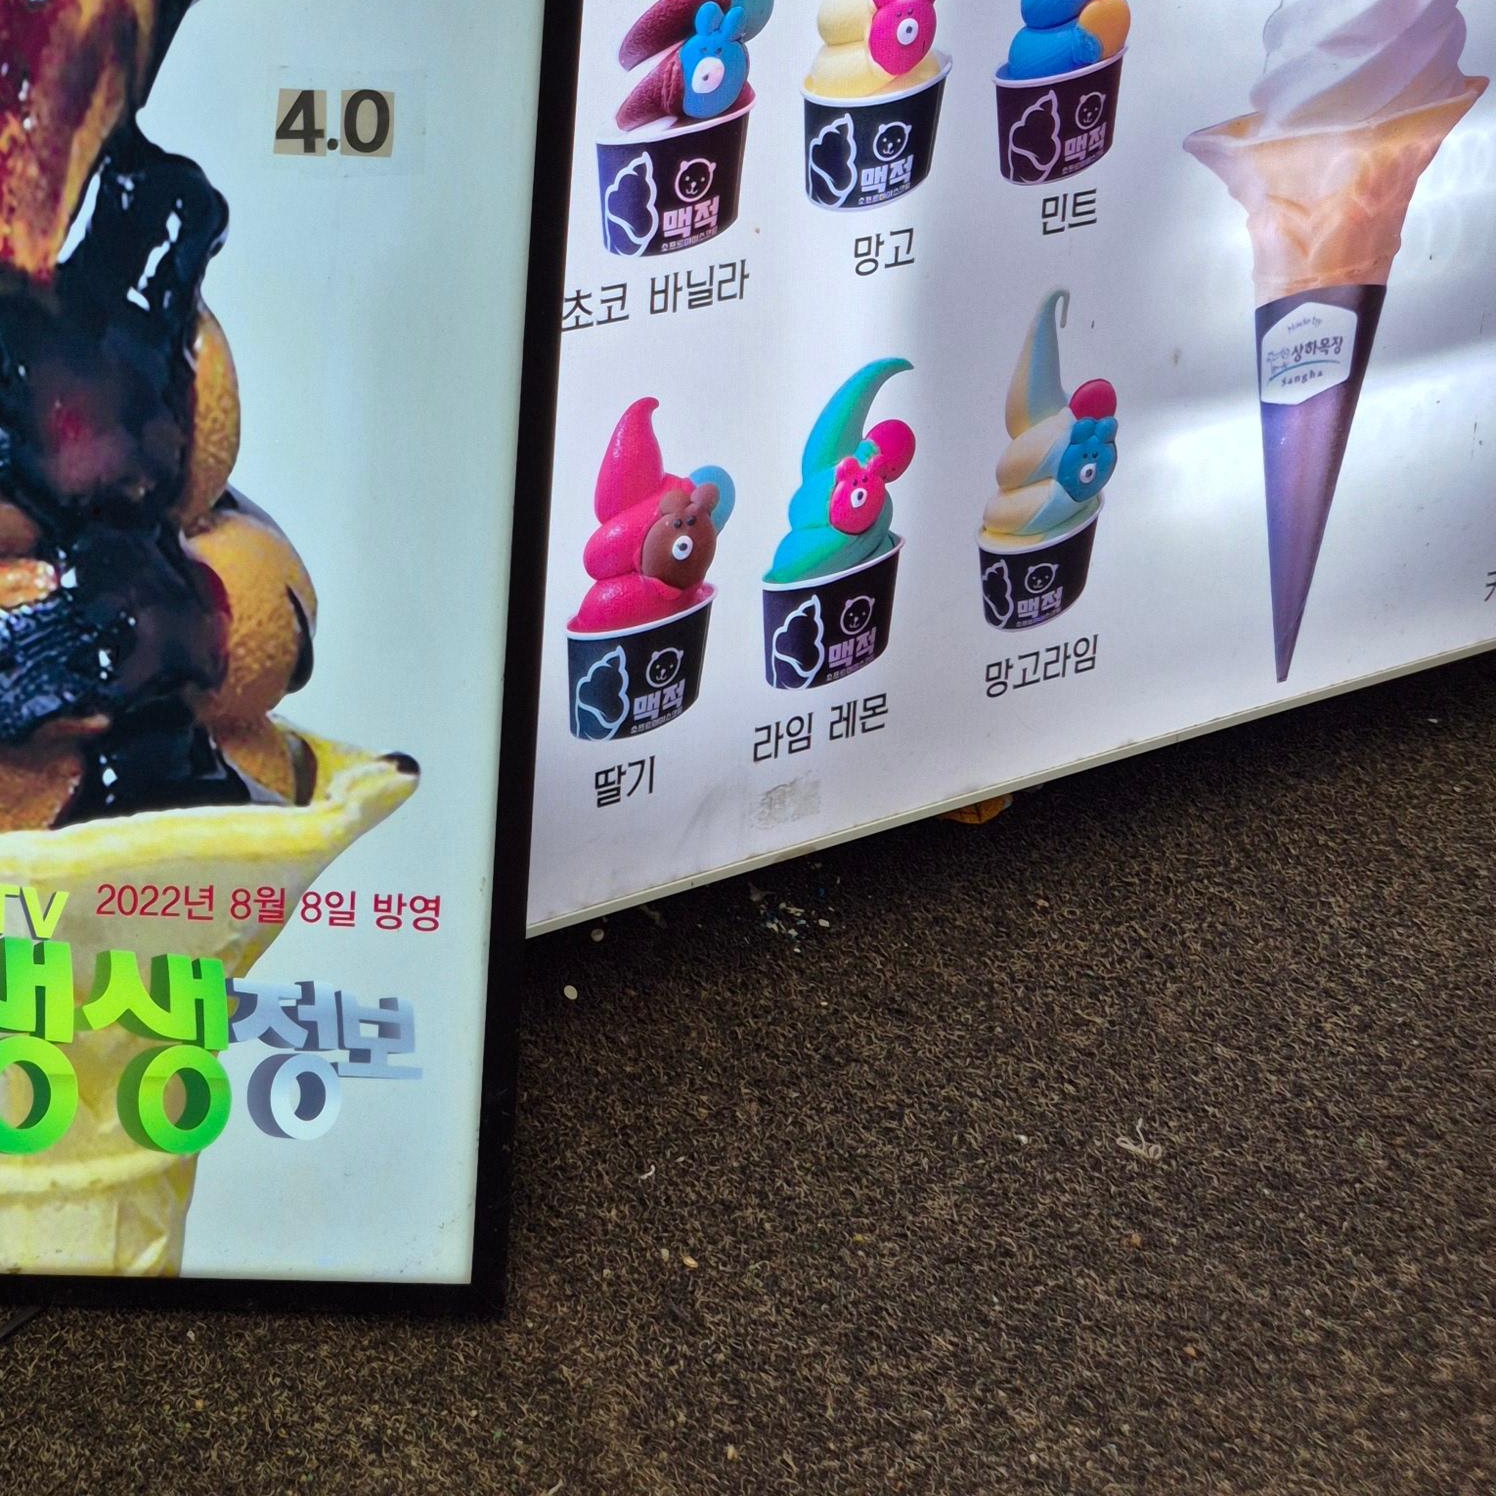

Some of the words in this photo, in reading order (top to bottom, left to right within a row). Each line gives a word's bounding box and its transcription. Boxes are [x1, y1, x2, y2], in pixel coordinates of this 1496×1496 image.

[275, 88, 390, 153] 4.0
[1064, 121, 1108, 163] 맥적
[861, 154, 914, 193] 맥적
[662, 195, 720, 239] 맥적
[1041, 187, 1098, 236] 민트
[854, 227, 915, 277] 망고
[562, 282, 630, 332] 초코
[649, 258, 750, 315] 바닐라
[1017, 586, 1064, 619] 맥적
[828, 626, 877, 669] 맥적
[985, 633, 1100, 699] 망고라임
[633, 677, 686, 721] 맥적
[753, 711, 814, 763] 라임
[829, 692, 889, 741] 레몬
[594, 754, 657, 809] 딸기
[95, 882, 214, 922] 2022년
[229, 886, 287, 925] 8월
[300, 890, 357, 928] 8일
[372, 893, 442, 932] 방영
